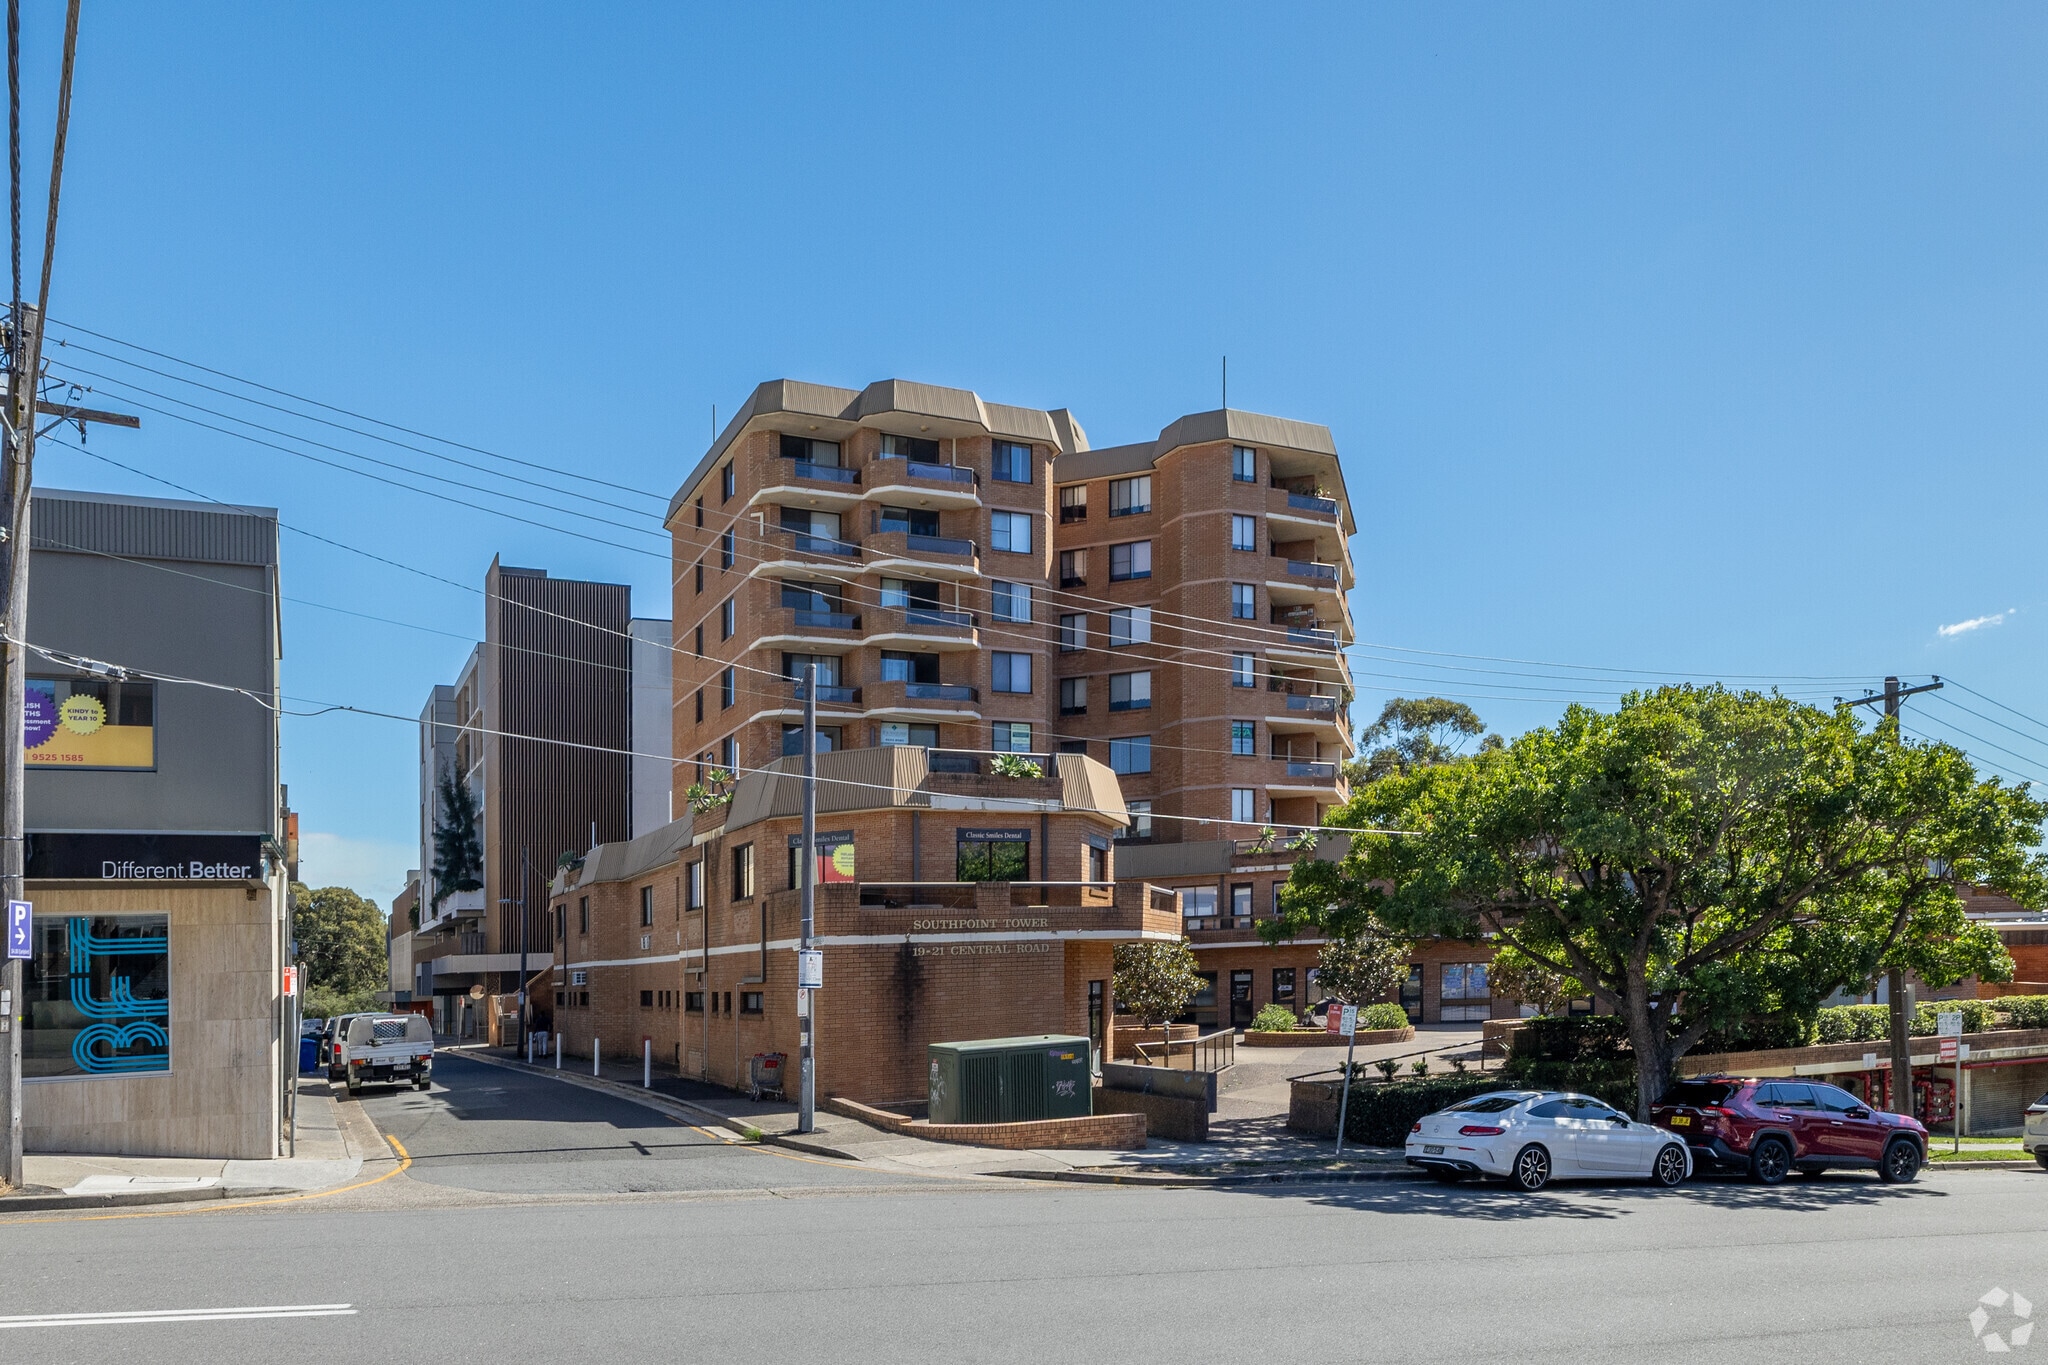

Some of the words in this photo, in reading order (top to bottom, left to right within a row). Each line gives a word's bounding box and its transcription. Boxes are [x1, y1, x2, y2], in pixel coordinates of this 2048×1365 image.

[32, 753, 58, 761] 9525
[60, 754, 84, 762] 1585
[832, 833, 850, 842] Dental
[965, 831, 985, 839] Classic
[985, 831, 1004, 839] Smiles
[15, 905, 26, 926] P
[913, 919, 998, 930] SOUTHPOINT
[1003, 918, 1049, 928] TOWER
[912, 946, 945, 957] 19-21
[950, 944, 1011, 956] CENTRAL
[1016, 943, 1050, 953] ROAD
